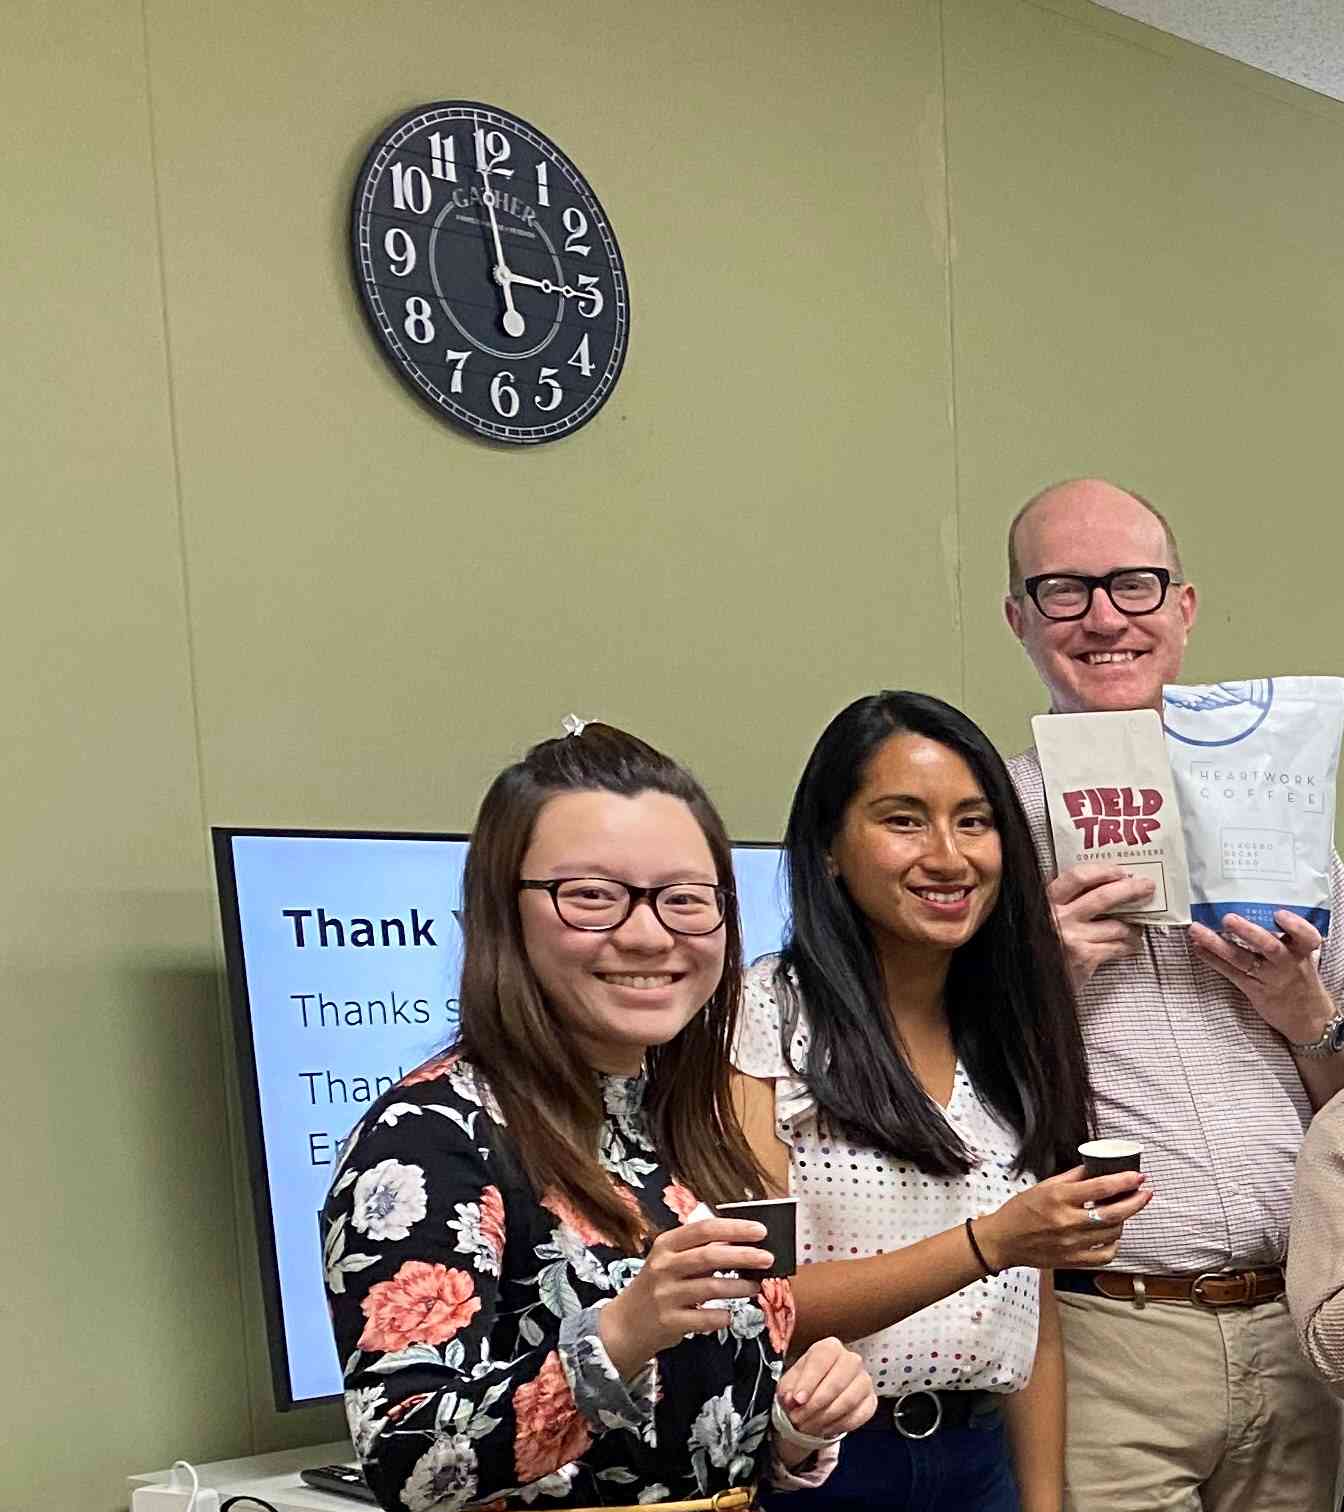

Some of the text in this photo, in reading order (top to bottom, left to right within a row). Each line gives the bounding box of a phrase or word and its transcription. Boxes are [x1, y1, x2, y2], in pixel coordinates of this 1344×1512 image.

[429, 131, 457, 182] 11
[474, 129, 515, 177] 12
[390, 162, 432, 214] 10
[536, 161, 550, 207] 1
[384, 228, 416, 276] 9
[562, 207, 592, 256] 2
[577, 274, 604, 318] 3
[404, 297, 435, 344] 8
[446, 350, 472, 393] 7
[568, 333, 596, 377] 4
[490, 371, 519, 418] 6
[534, 368, 563, 411] 5
[1200, 771, 1315, 786] HEARTWORK
[1200, 787, 1316, 805] COFFEE
[1062, 787, 1163, 818] FIELD
[1072, 816, 1161, 849] TRIP
[282, 908, 438, 948] Thank
[290, 991, 430, 1028] Thanks
